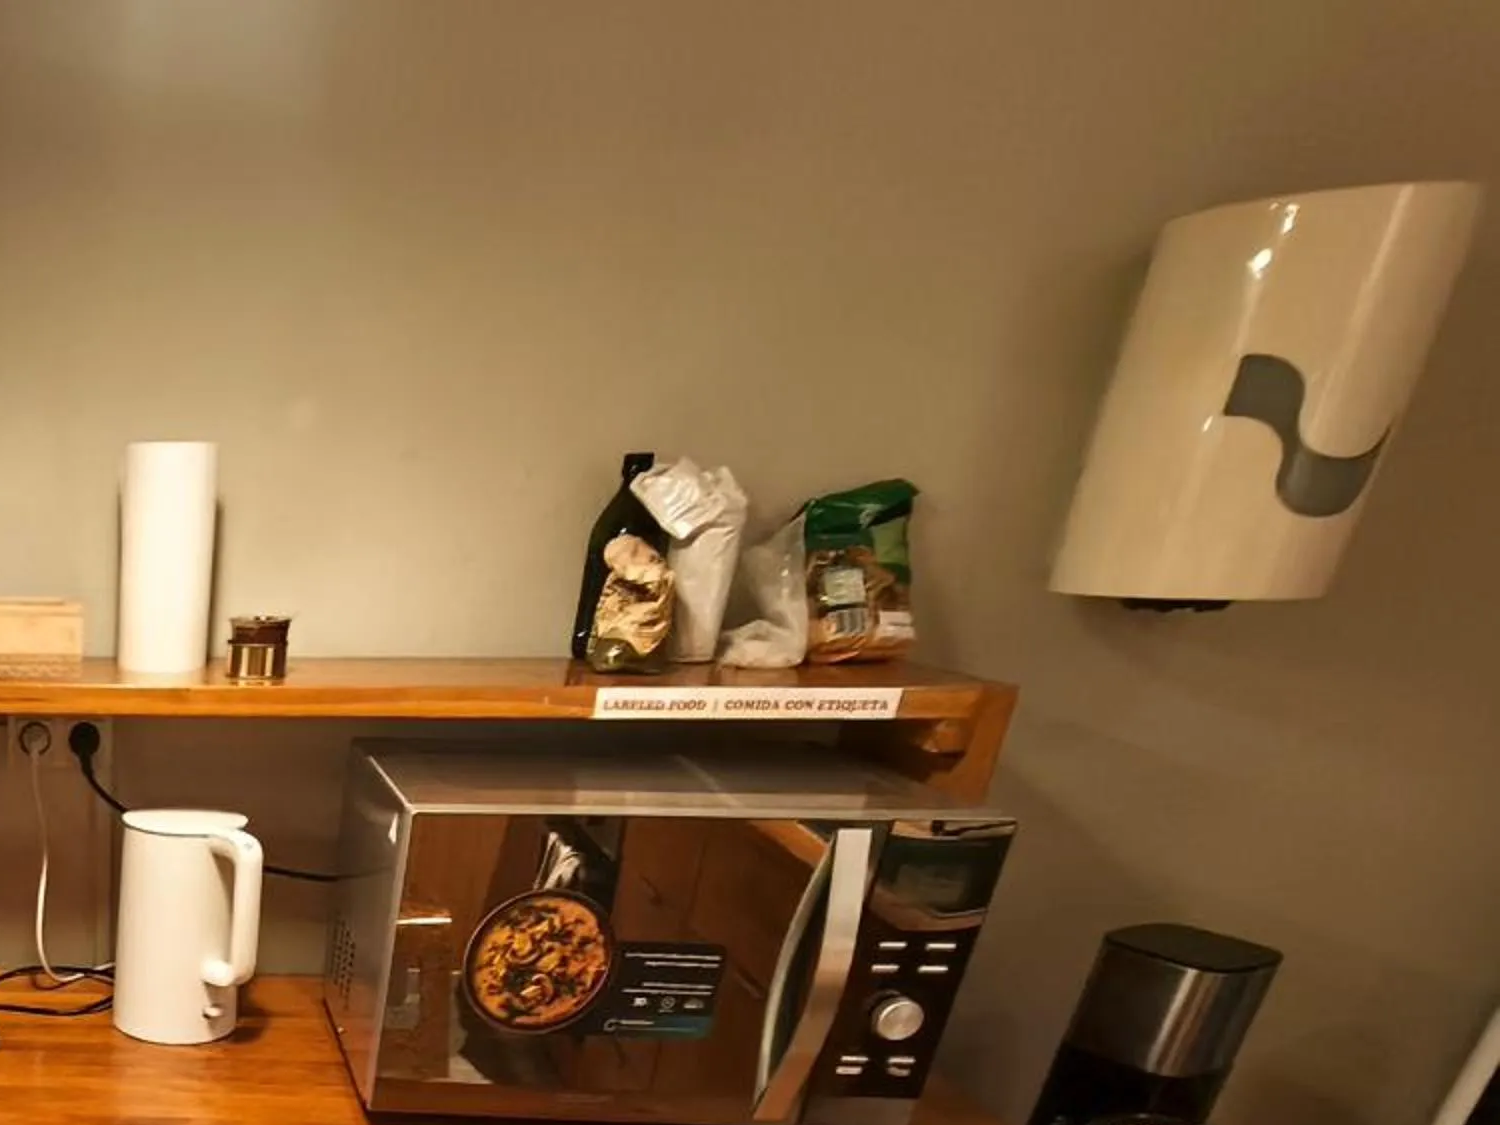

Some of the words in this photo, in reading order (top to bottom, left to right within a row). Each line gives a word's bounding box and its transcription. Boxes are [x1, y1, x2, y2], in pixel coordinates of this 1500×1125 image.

[604, 700, 665, 711] LABELED
[668, 700, 707, 712] FOOD
[724, 699, 780, 711] COMIDA
[785, 700, 814, 711] CON
[817, 700, 889, 712] ETIQUETA
